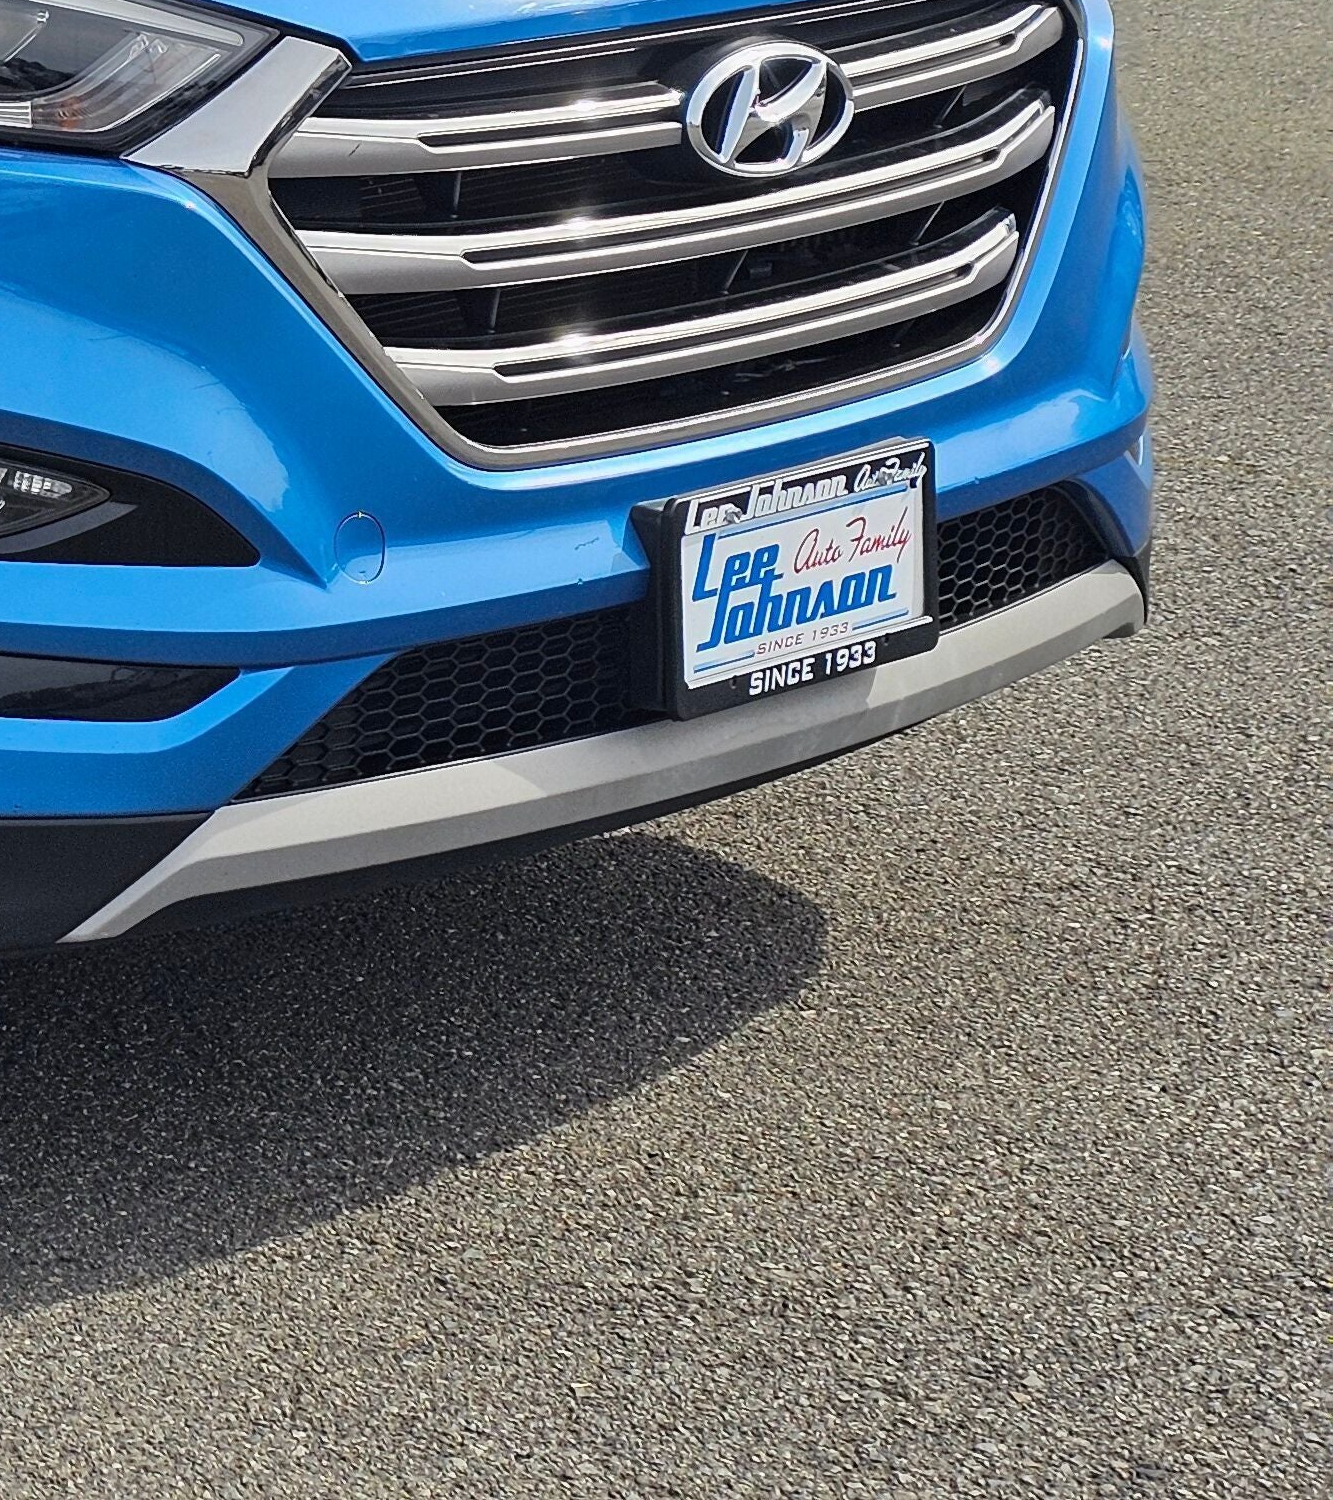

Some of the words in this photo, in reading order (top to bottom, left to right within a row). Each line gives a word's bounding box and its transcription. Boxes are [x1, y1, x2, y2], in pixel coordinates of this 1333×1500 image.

[740, 475, 849, 520] Johnson
[854, 464, 889, 492] Aut
[880, 451, 928, 488] Family
[692, 534, 780, 601] Lee
[793, 528, 842, 574] Auto
[846, 506, 912, 563] Family
[697, 564, 896, 652] Johnson
[757, 632, 804, 655] SINCE
[812, 621, 850, 641] 1933
[749, 658, 814, 696] SINCE
[824, 641, 877, 676] 1933
